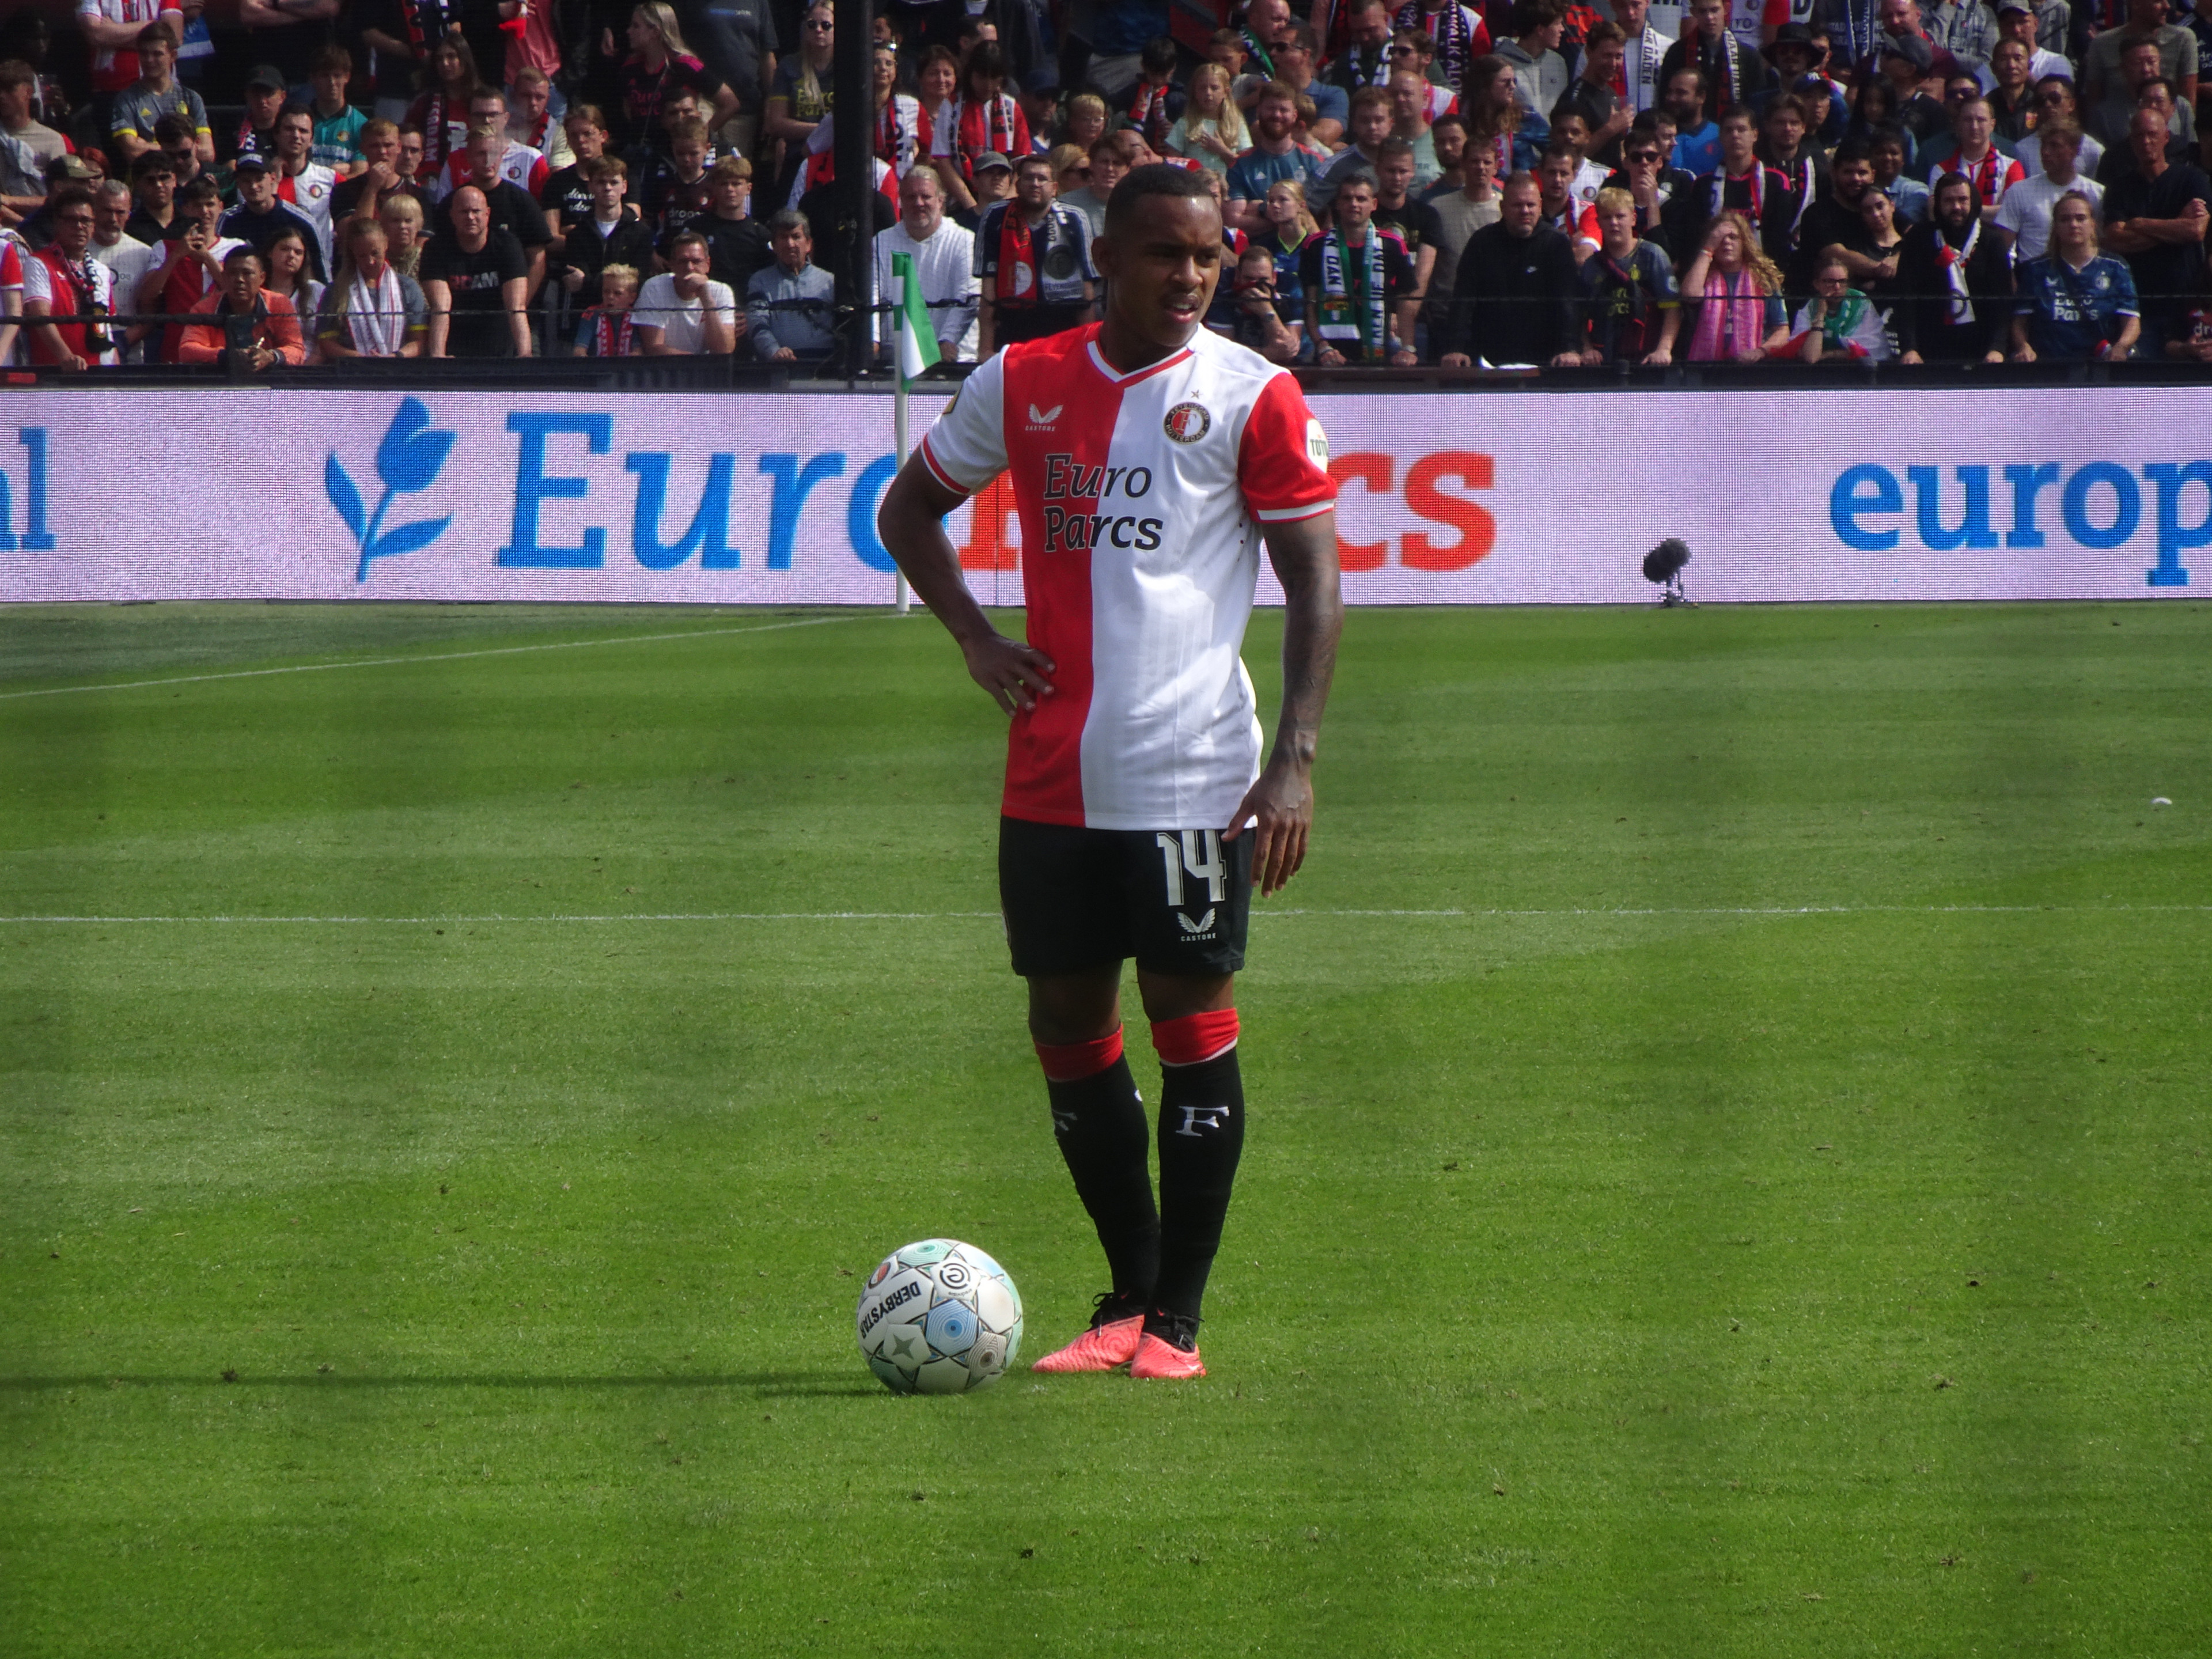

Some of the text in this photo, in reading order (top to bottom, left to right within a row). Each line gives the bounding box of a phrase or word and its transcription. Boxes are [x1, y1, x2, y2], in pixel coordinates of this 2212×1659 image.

[1642, 46, 1654, 84] DADEN
[1043, 453, 1152, 500] Euro
[1043, 505, 1164, 553] Parcs
[1157, 830, 1228, 906] 14
[1180, 932, 1217, 942] CASTORE
[1175, 1105, 1230, 1137] F
[859, 1280, 922, 1340] DERBYSTAR
